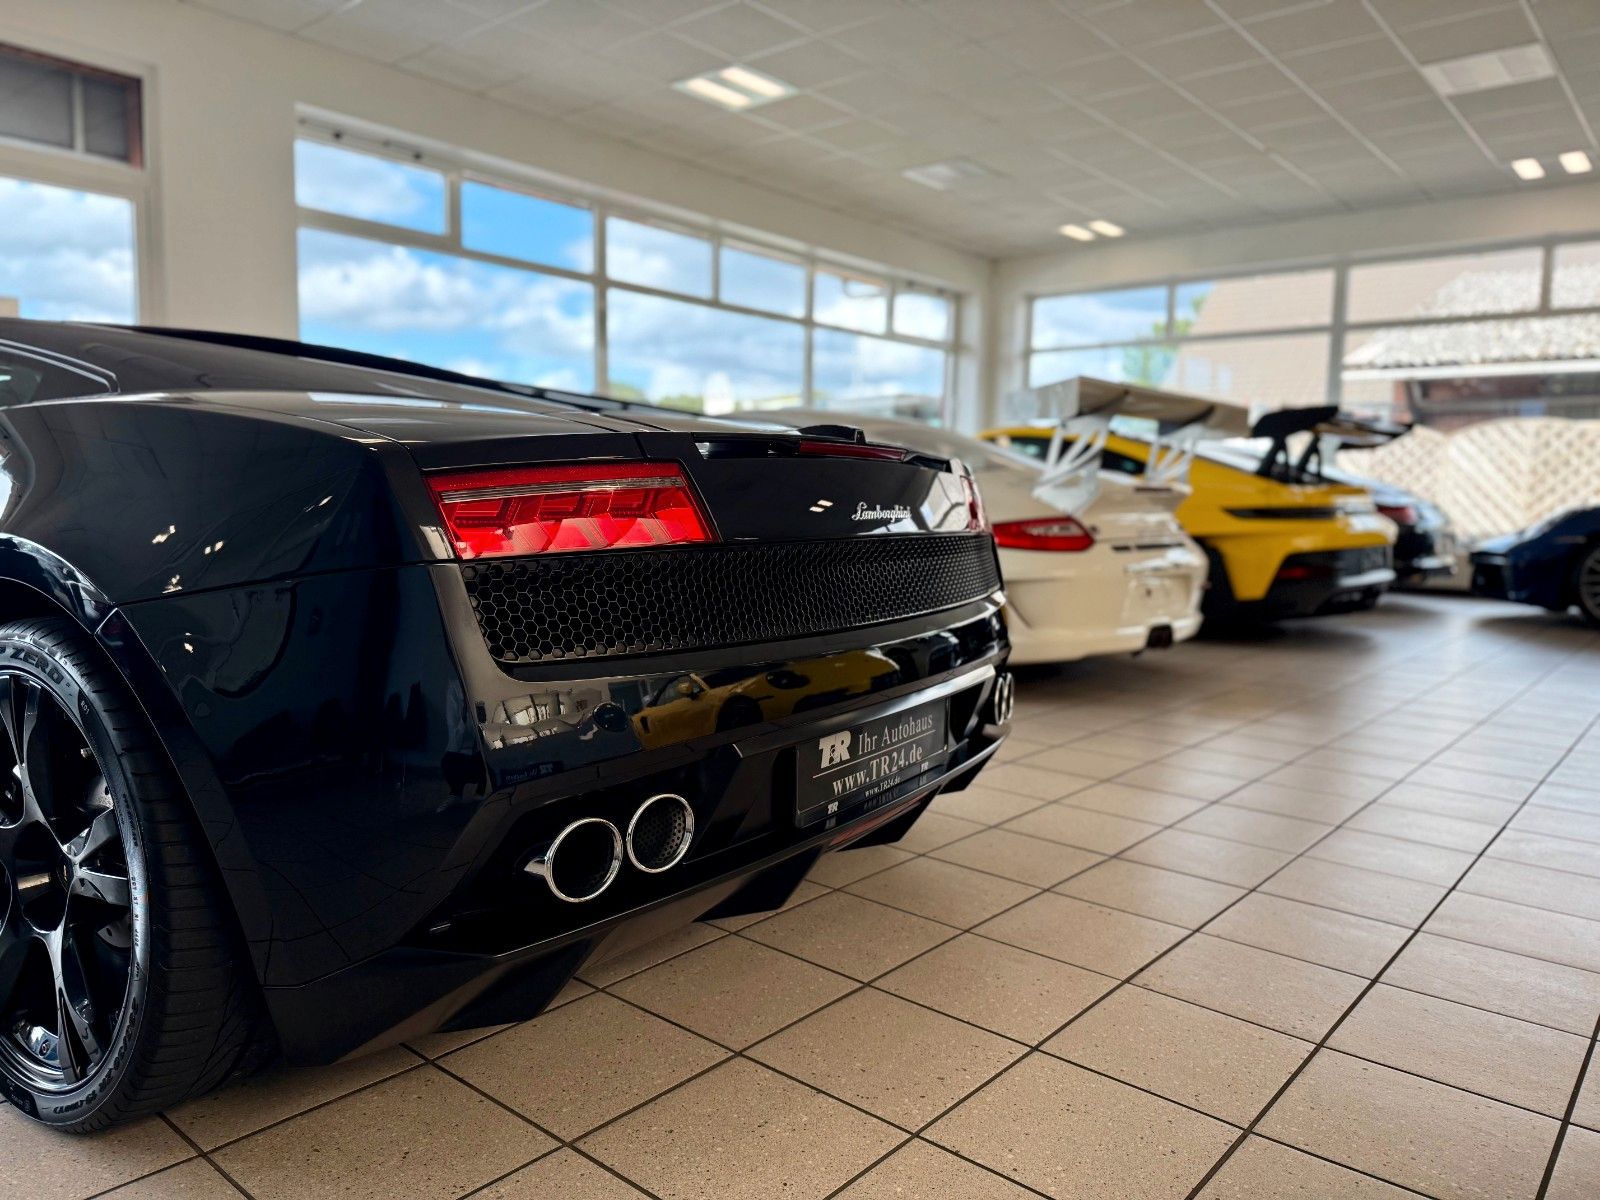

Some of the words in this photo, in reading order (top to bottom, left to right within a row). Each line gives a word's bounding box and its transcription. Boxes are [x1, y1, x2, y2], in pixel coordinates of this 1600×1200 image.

[851, 501, 911, 523] Lamborghini
[10, 647, 64, 684] ZERO
[858, 732, 878, 755] Ihr
[881, 714, 933, 745] Autohaus
[832, 744, 923, 795] www.TR24.de
